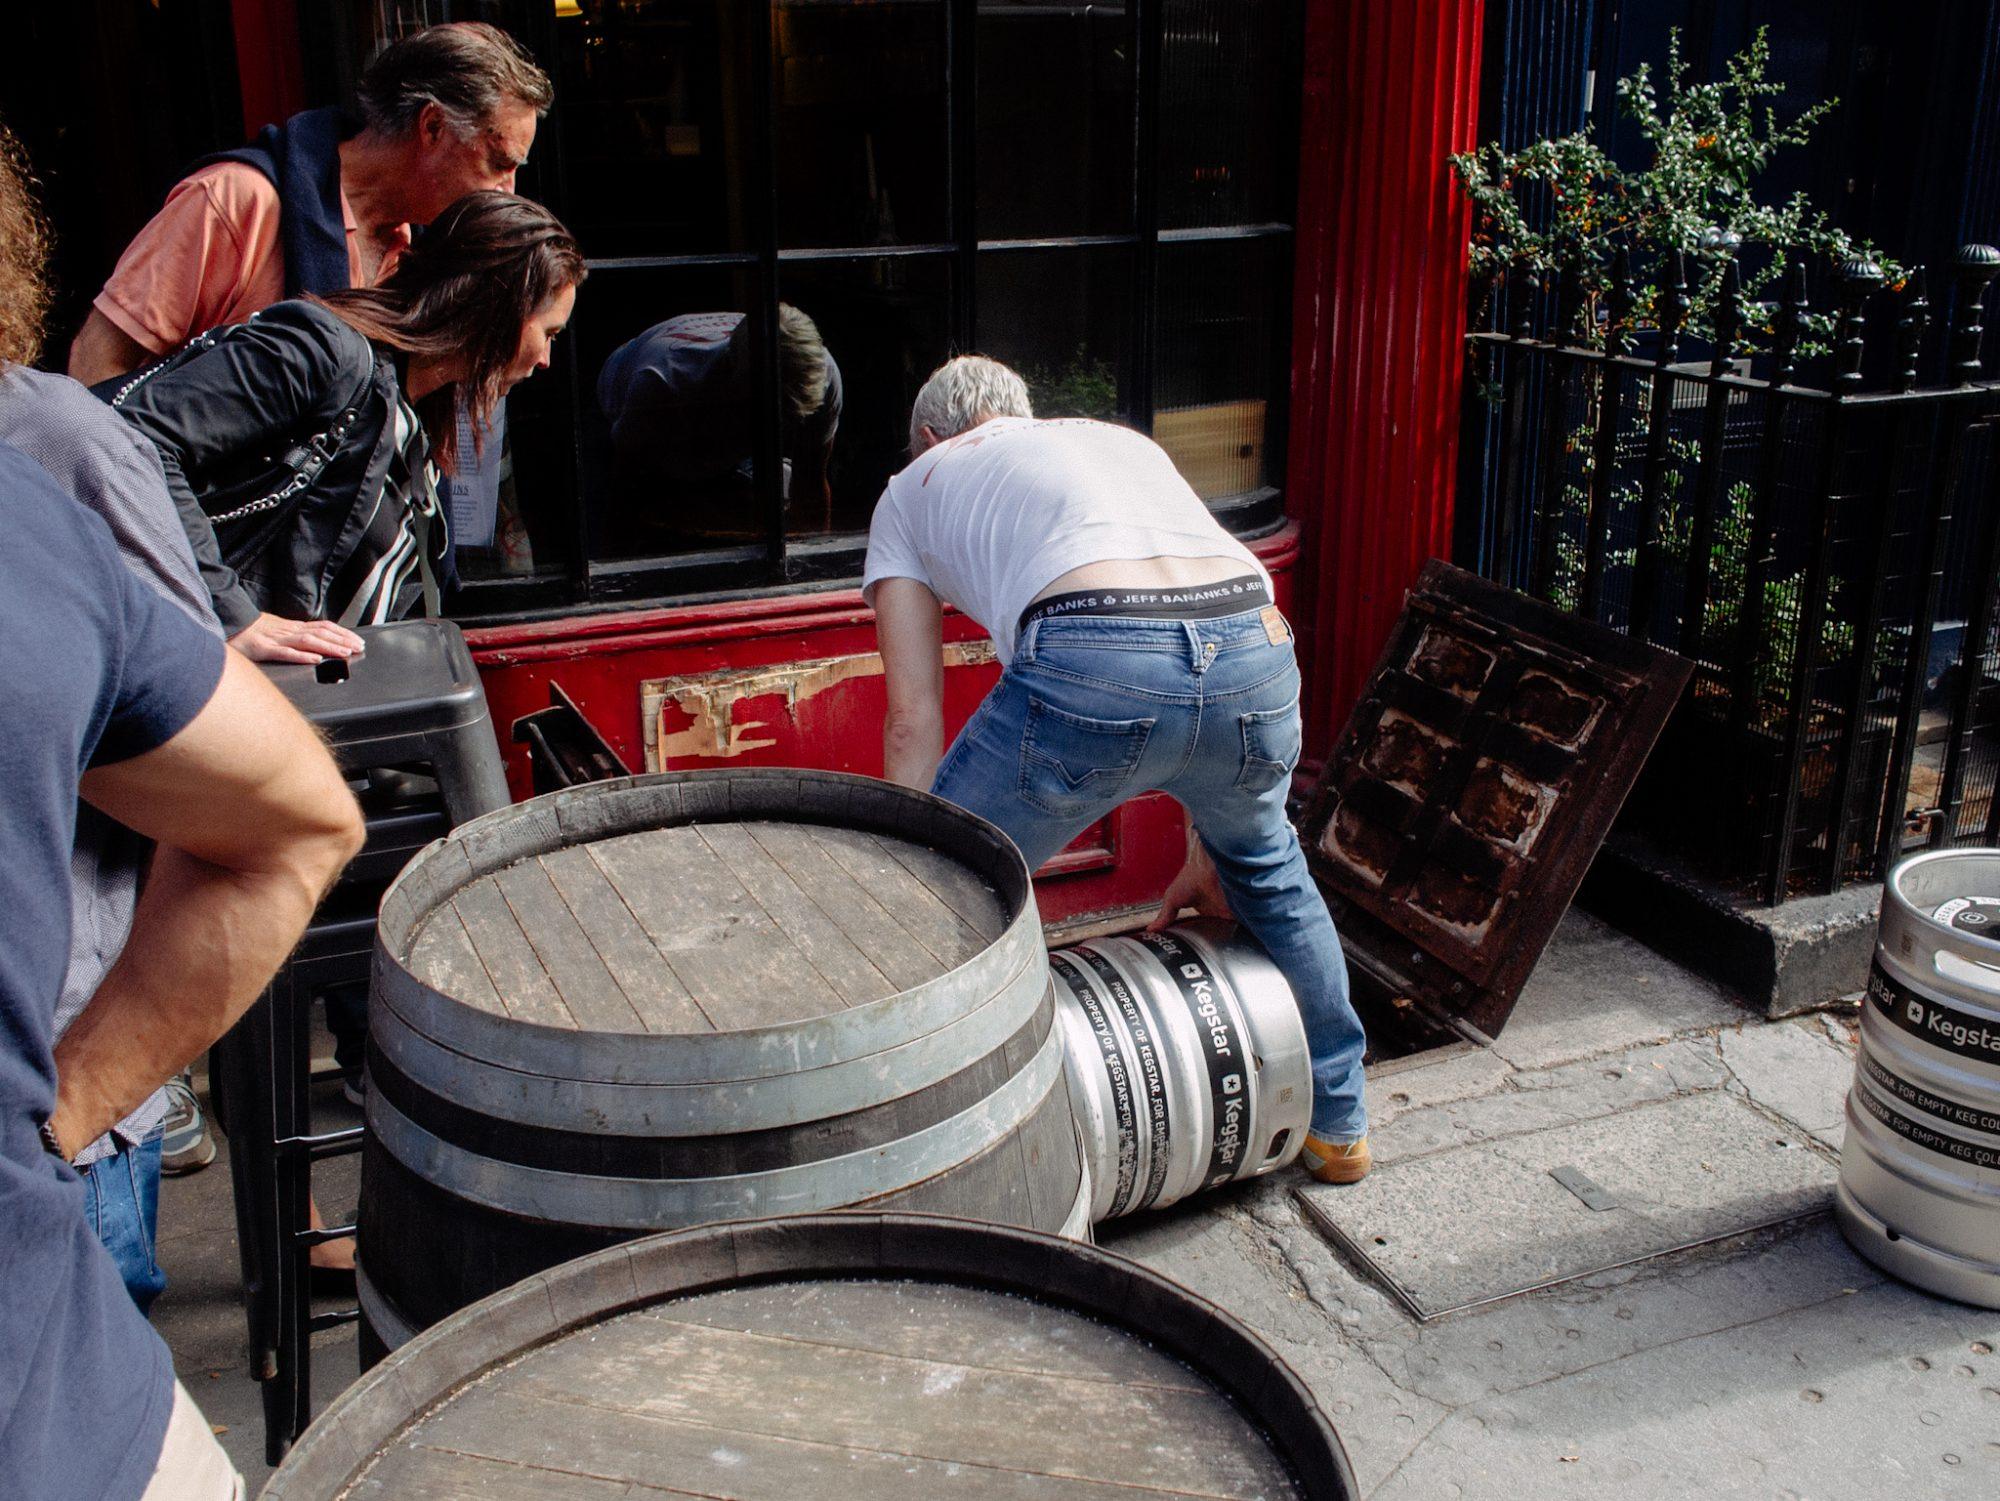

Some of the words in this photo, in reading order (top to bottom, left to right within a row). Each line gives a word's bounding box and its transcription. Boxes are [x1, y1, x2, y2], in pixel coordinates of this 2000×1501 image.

[1046, 598, 1098, 616] BANKS
[1122, 595, 1158, 604] JEFF
[1141, 932, 1183, 957] gstar
[1111, 981, 1141, 1030] PROPERTY
[1870, 974, 1897, 1006] gstar
[1079, 989, 1110, 1036] PROPERTY
[1191, 980, 1232, 1057] Kegstar
[1927, 1010, 2000, 1052] Kegsta
[1102, 1034, 1116, 1053] OF
[1134, 1029, 1148, 1045] OF
[1107, 1053, 1128, 1106] KEGSTAR.
[1140, 1044, 1161, 1096] KEGSTAR.
[1151, 1097, 1165, 1121] FOR
[1898, 1084, 1916, 1101] FOR
[1918, 1095, 1953, 1116] EMPTY
[1955, 1108, 1978, 1126] KEG
[1981, 1116, 2000, 1131] COL
[1219, 1098, 1244, 1165] Kegstar
[1893, 1117, 1911, 1134] FOR
[1912, 1128, 1948, 1149] EMPTY
[1949, 1143, 1972, 1160] KEG
